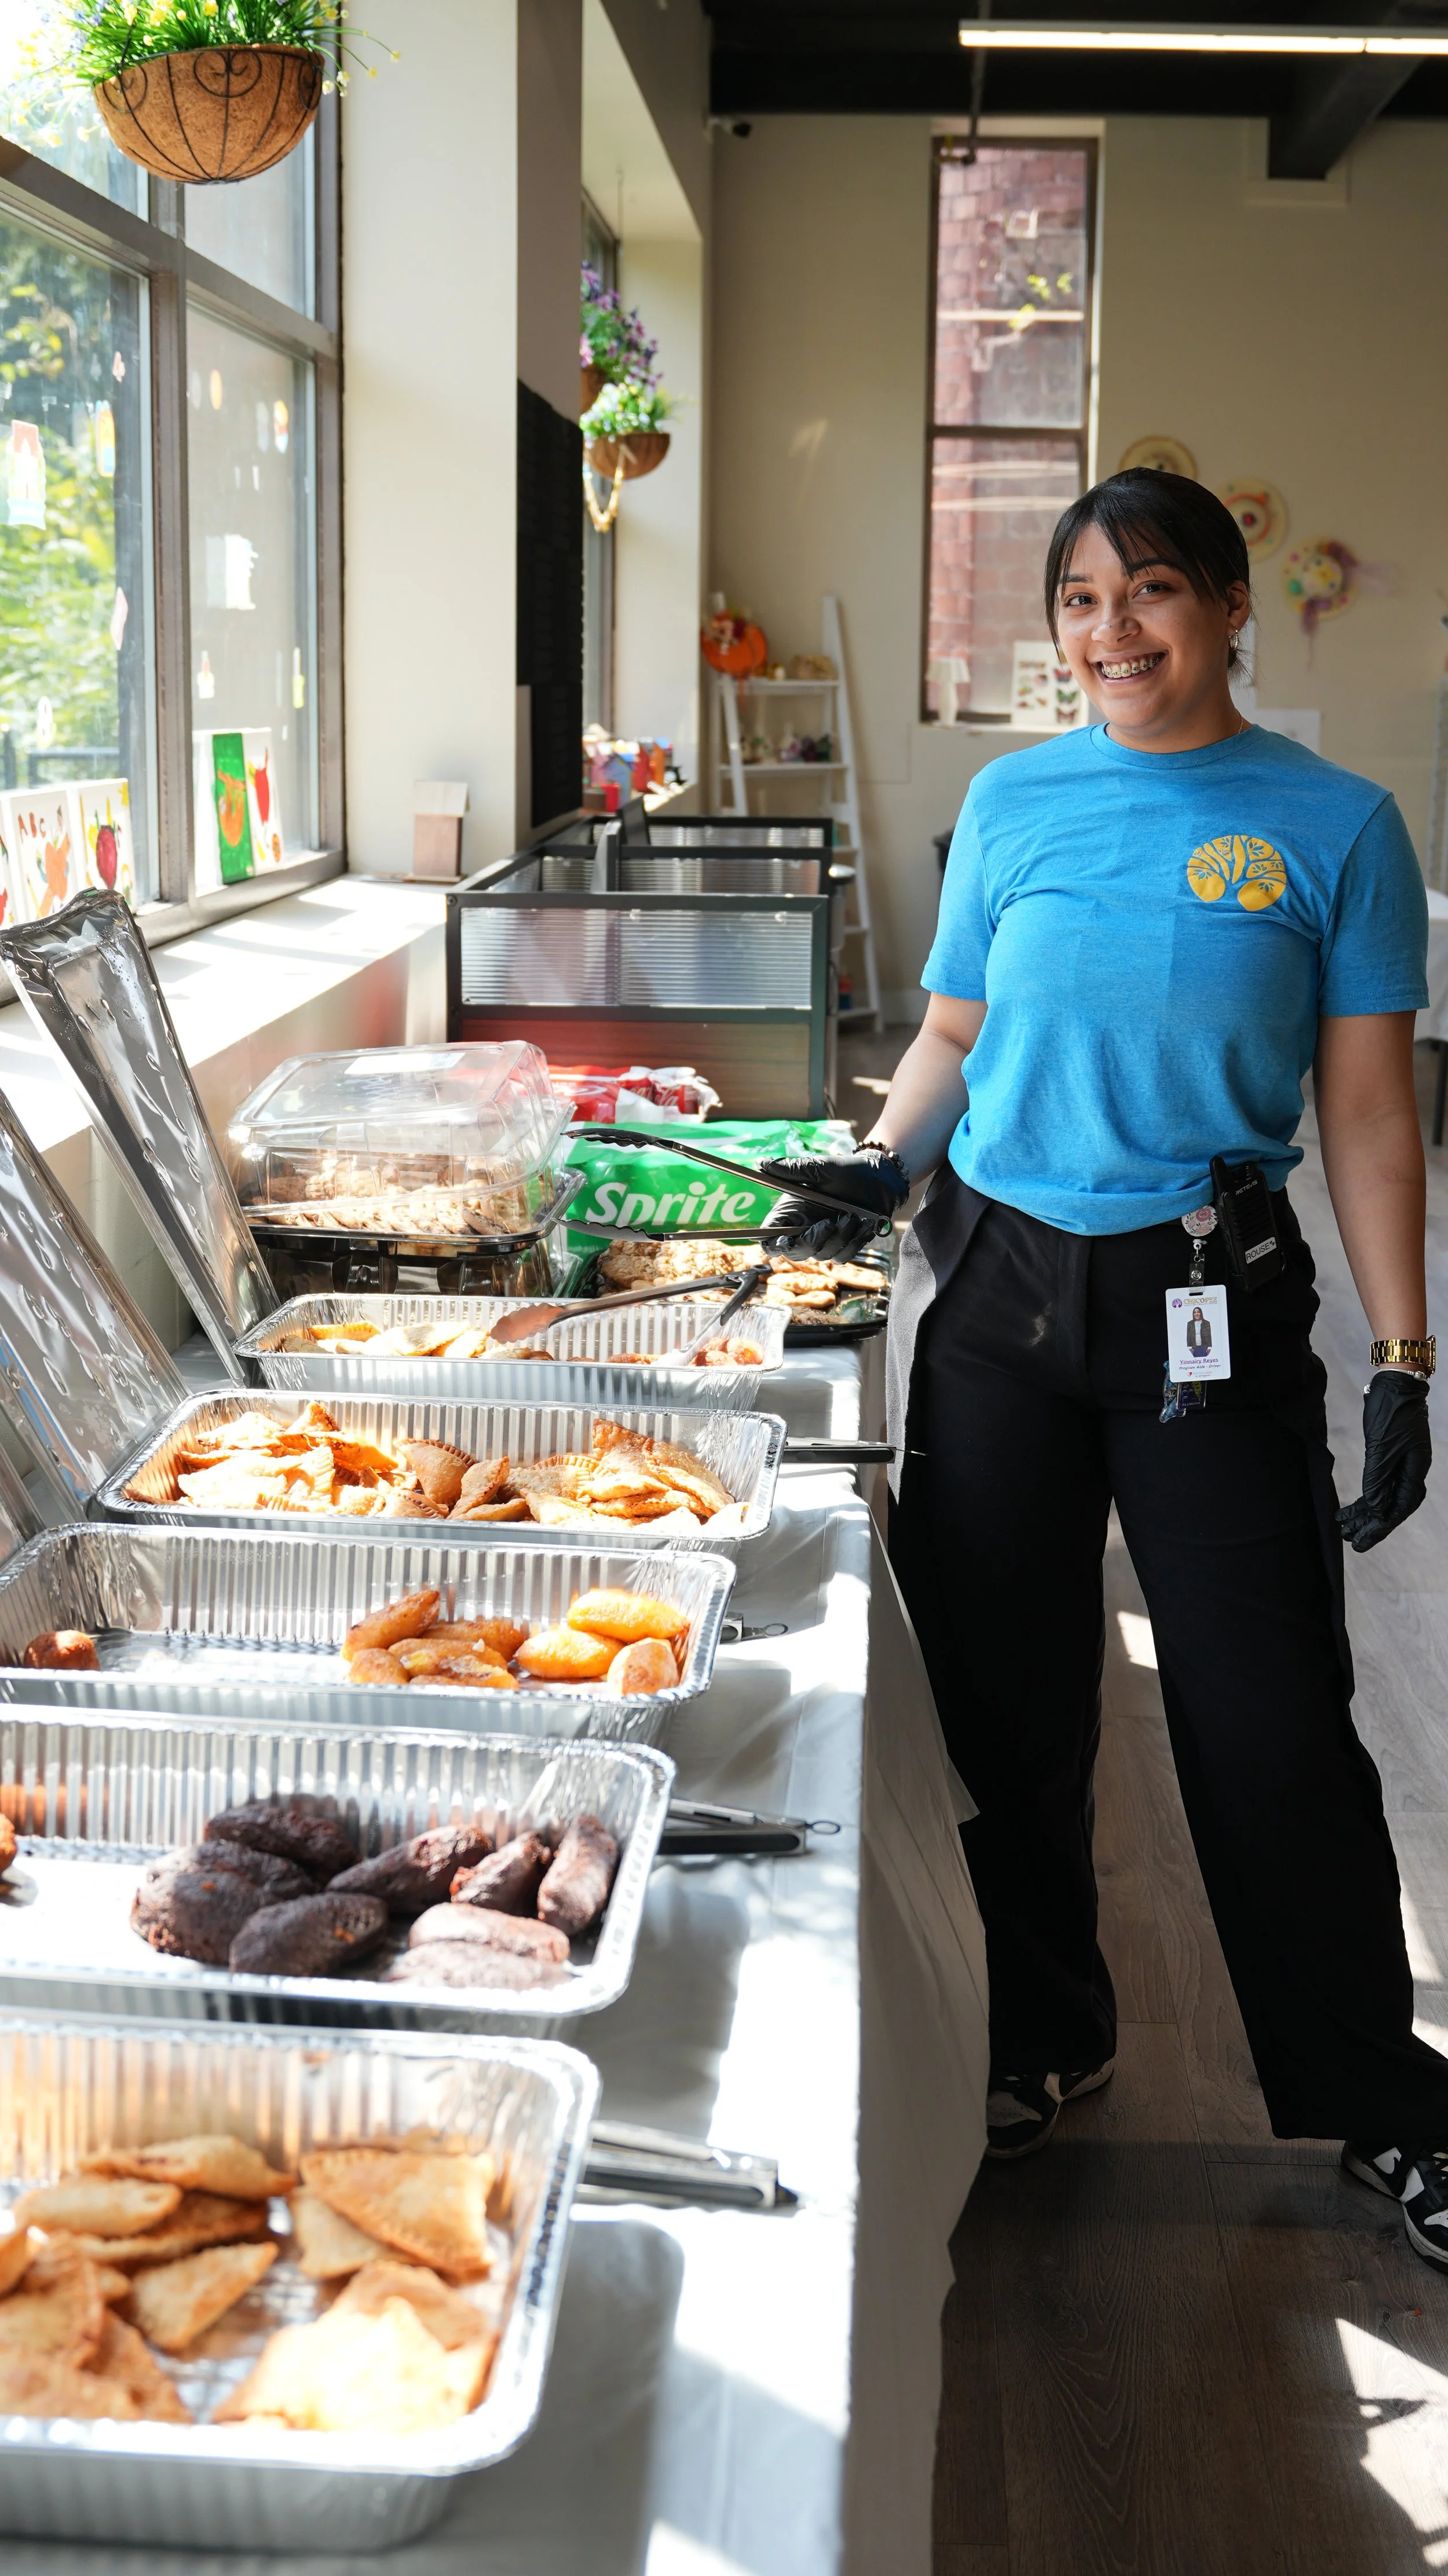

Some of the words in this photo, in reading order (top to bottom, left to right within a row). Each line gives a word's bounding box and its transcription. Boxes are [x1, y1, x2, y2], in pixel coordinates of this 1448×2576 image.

[1235, 1180, 1257, 1195] RETEVIS
[585, 1181, 756, 1226] Sprite
[1246, 1242, 1270, 1260] ROUSE
